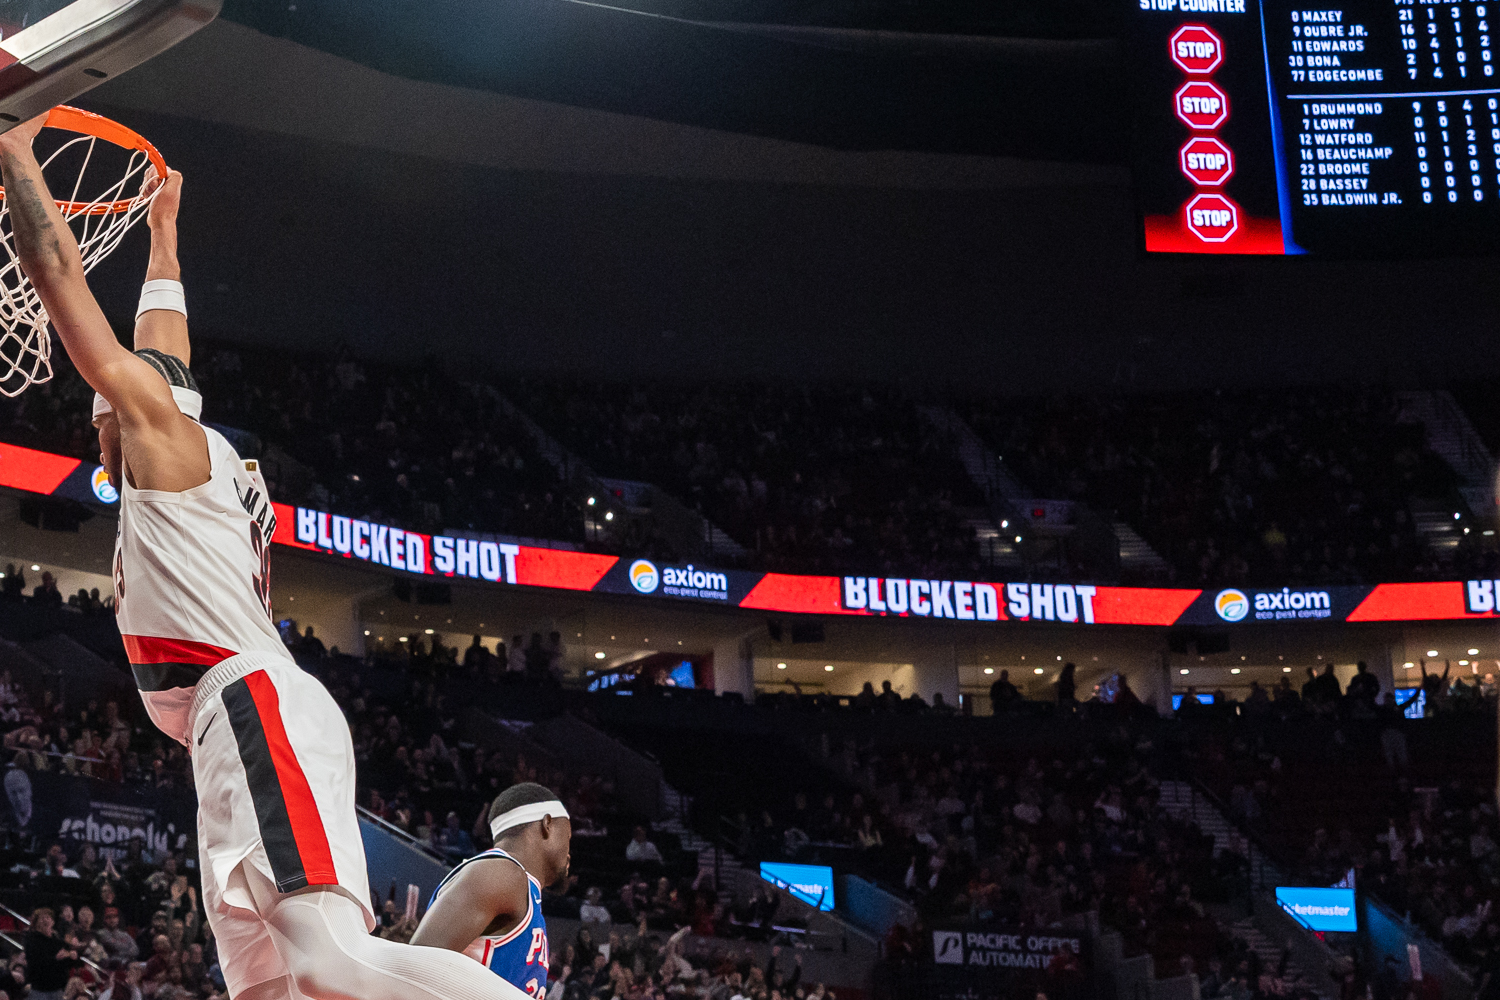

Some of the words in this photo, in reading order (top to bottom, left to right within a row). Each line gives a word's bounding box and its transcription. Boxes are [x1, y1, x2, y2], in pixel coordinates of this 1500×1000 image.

[1140, 0, 1177, 11] STOP
[1180, 0, 1245, 13] COUNTER
[1292, 12, 1299, 22] 0
[1303, 11, 1342, 21] MAXEY
[1399, 10, 1412, 20] 21
[1428, 8, 1433, 19] 1
[1452, 8, 1459, 18] 3
[1477, 6, 1485, 16] 0
[1293, 26, 1300, 36] 9
[1304, 26, 1343, 36] OUBRE
[1349, 26, 1367, 36] JR.
[1401, 24, 1414, 35] 16
[1428, 24, 1436, 34] 3
[1455, 22, 1460, 32] 1
[1479, 21, 1487, 30] 4
[1177, 41, 1215, 58] STOP
[1293, 41, 1302, 51] 11
[1306, 40, 1364, 51] EDWARDS
[1403, 39, 1416, 49] 10
[1430, 38, 1439, 48] 4
[1456, 37, 1462, 47] 1
[1481, 35, 1489, 46] 2
[1289, 56, 1303, 66] 30
[1307, 56, 1340, 66] BONA
[1407, 54, 1415, 64] 2
[1433, 53, 1438, 63] 1
[1457, 52, 1465, 62] 0
[1483, 50, 1490, 61] 0
[1292, 71, 1304, 81] 77
[1309, 70, 1382, 81] EDGECOMBE
[1408, 69, 1416, 79] 7
[1434, 68, 1442, 77] 4
[1460, 66, 1465, 76] 1
[1484, 65, 1492, 75] 0
[1182, 97, 1220, 114] STOP
[1304, 105, 1308, 115] 1
[1312, 103, 1382, 115] DRUMMOND
[1413, 102, 1420, 112] 9
[1438, 101, 1445, 111] 5
[1463, 100, 1471, 110] 4
[1489, 99, 1496, 109] 0
[1303, 119, 1309, 130] 7
[1314, 119, 1354, 130] LOWRY
[1415, 117, 1422, 127] 0
[1440, 116, 1447, 126] 0
[1466, 115, 1471, 125] 1
[1492, 114, 1497, 124] 1
[1300, 134, 1312, 145] 12
[1315, 133, 1372, 144] WATFORD
[1415, 132, 1425, 142] 11
[1442, 131, 1447, 141] 1
[1467, 130, 1475, 140] 2
[1492, 129, 1500, 139] 0
[1301, 149, 1312, 160] 16
[1317, 148, 1392, 159] BEAUCHAMP
[1418, 147, 1425, 157] 0
[1444, 146, 1449, 156] 1
[1469, 145, 1476, 155] 3
[1494, 144, 1500, 154] 0
[1187, 152, 1226, 170] STOP
[1301, 164, 1315, 175] 22
[1319, 163, 1369, 174] BROOME
[1420, 162, 1427, 172] 0
[1445, 161, 1453, 171] 0
[1470, 160, 1478, 170] 0
[1302, 179, 1316, 190] 28
[1320, 179, 1367, 190] BASSEY
[1422, 177, 1429, 187] 0
[1447, 176, 1454, 186] 0
[1472, 175, 1480, 186] 0
[1304, 194, 1318, 205] 35
[1322, 194, 1377, 205] BALDWIN
[1382, 193, 1401, 204] JR.
[1424, 192, 1431, 203] 0
[1449, 191, 1456, 202] 0
[1474, 190, 1482, 200] 0
[1192, 208, 1231, 227] STOP
[298, 508, 424, 574] BLOCKED
[433, 536, 520, 584] SHOT
[663, 564, 728, 590] axiom
[844, 576, 998, 621] BLOCKED
[1007, 582, 1096, 624] SHOT
[1254, 587, 1330, 610] axiom
[966, 932, 1021, 950] PACIFIC
